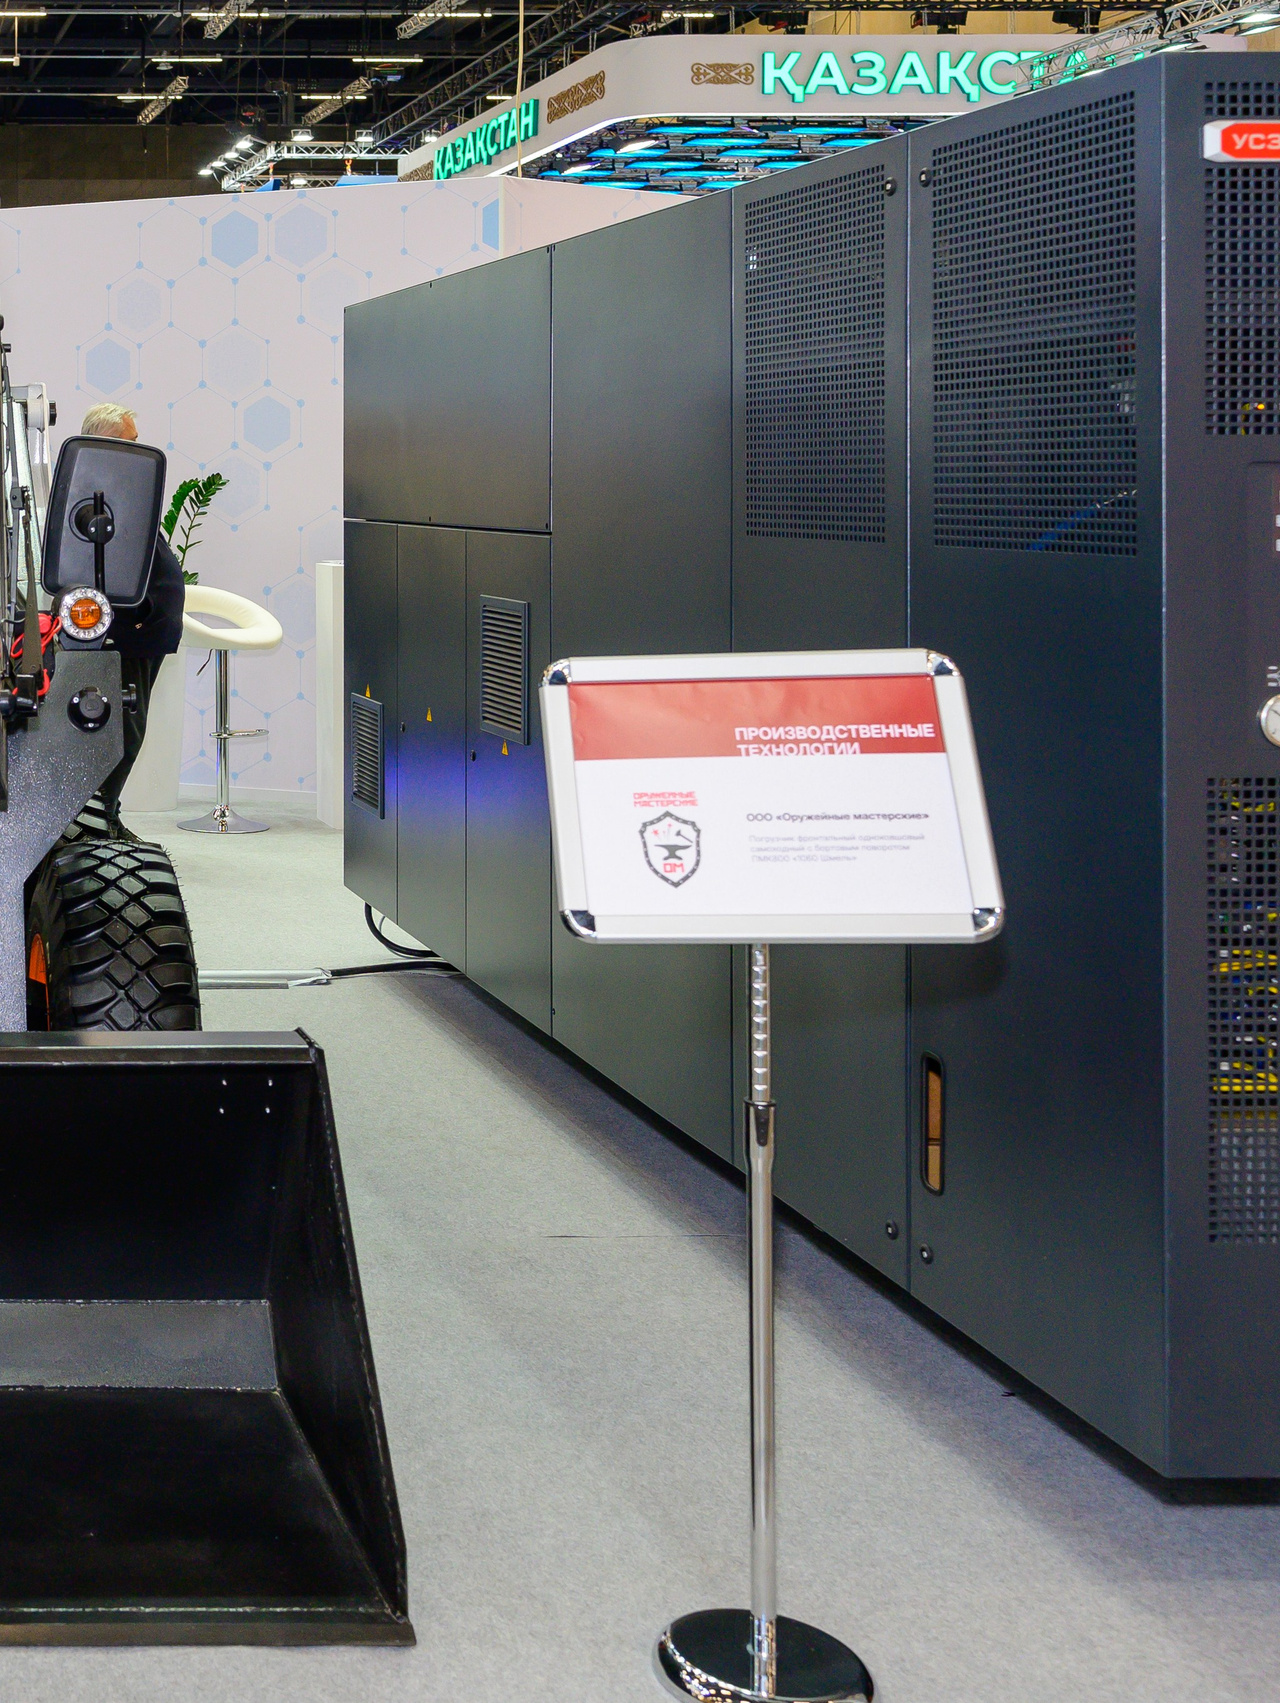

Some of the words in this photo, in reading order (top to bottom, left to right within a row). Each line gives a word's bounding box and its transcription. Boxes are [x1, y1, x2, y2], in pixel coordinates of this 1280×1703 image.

[433, 98, 539, 180] ҚАЗАҚСТАН
[734, 723, 936, 741] ПРОИЗВОДСТВЕННЫЕ
[736, 742, 861, 757] ТЕХНОЛОГИИ
[746, 812, 773, 822] ООО
[775, 811, 851, 824] «Оружейные
[853, 812, 930, 822] мастерские»
[663, 862, 685, 874] ОМ
